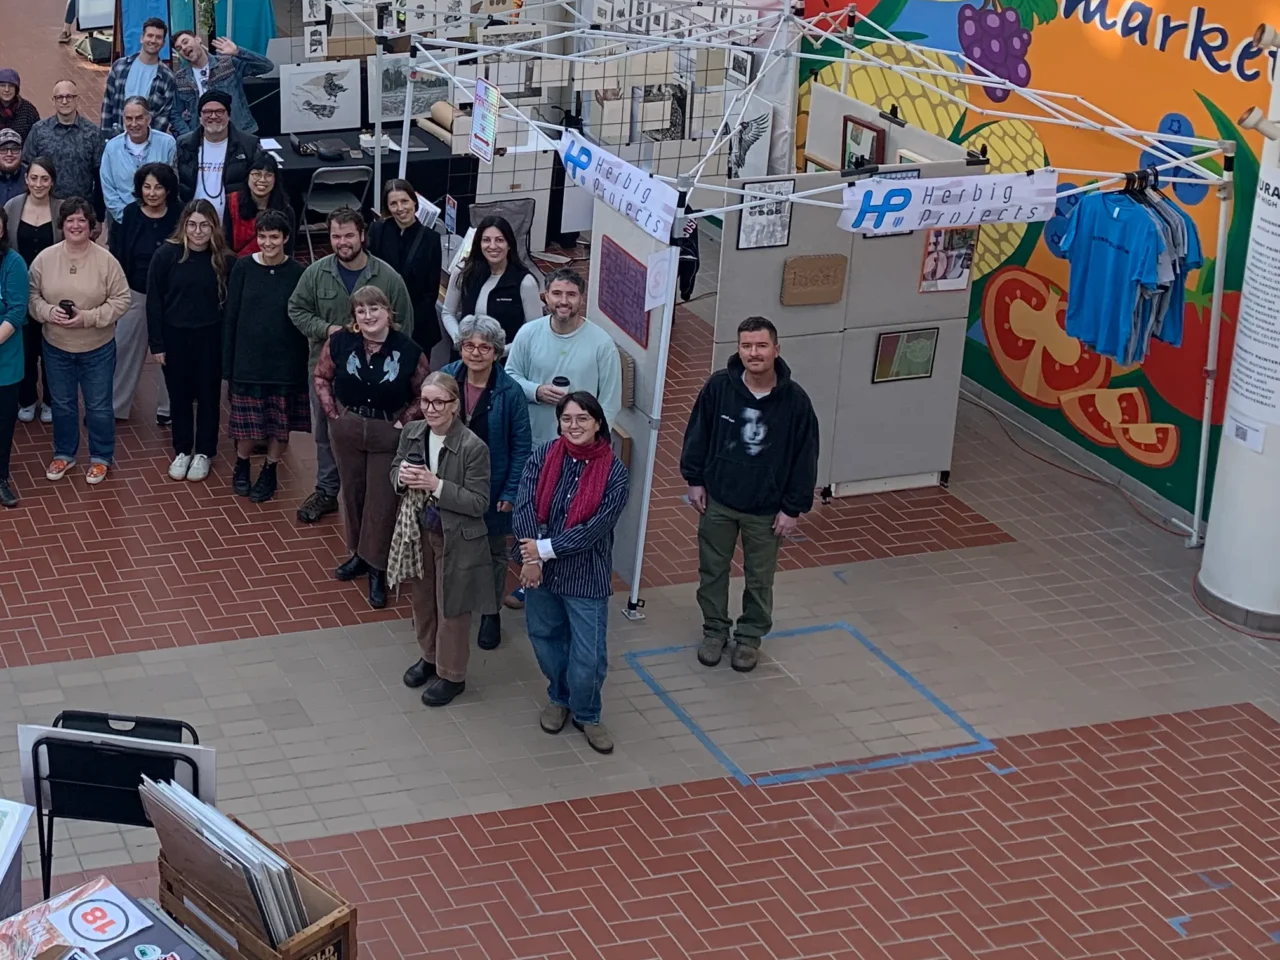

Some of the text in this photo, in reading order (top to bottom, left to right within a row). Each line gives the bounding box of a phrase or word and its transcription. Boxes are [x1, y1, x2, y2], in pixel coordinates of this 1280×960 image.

[594, 156, 652, 204] Herbig
[922, 183, 1013, 204] Herbig
[81, 906, 117, 934] 18
